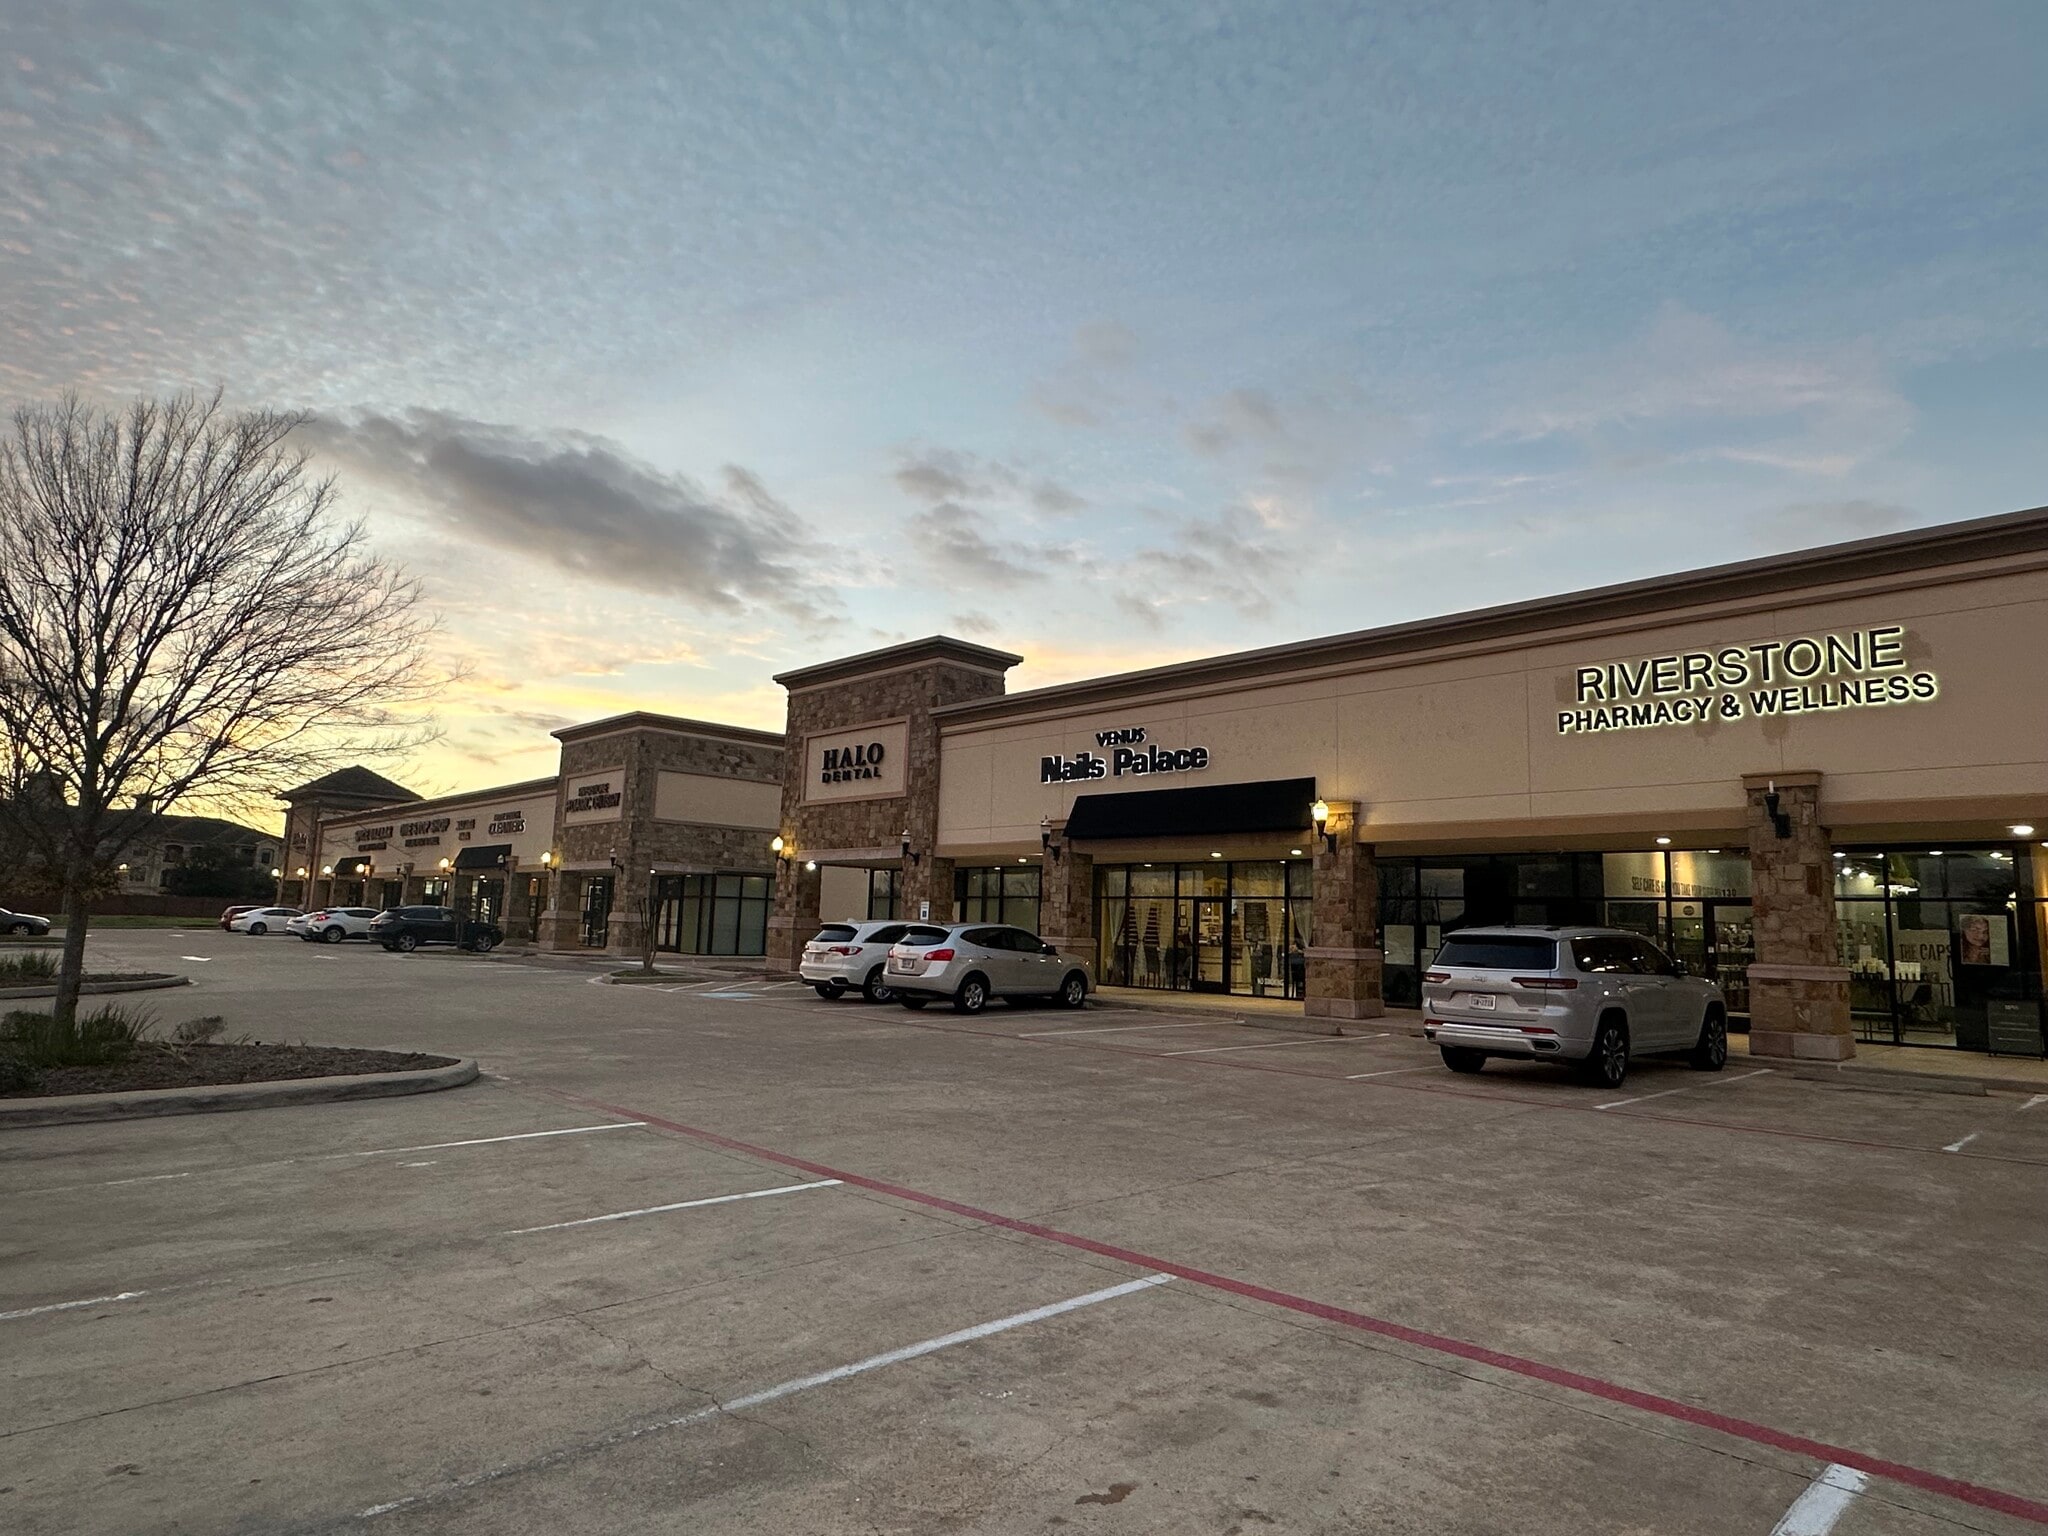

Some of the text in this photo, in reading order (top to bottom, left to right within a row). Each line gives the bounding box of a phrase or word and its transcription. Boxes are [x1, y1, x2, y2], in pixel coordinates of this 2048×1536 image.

[1576, 626, 1905, 702] RIVERSTONE
[1558, 672, 1936, 733] PHARMACY & WELLNESS
[1096, 727, 1146, 747] VENUS
[822, 742, 885, 771] HALO
[1041, 745, 1209, 783] Nails Palace
[822, 767, 882, 783] DENTAL
[1900, 943, 1918, 960] THE
